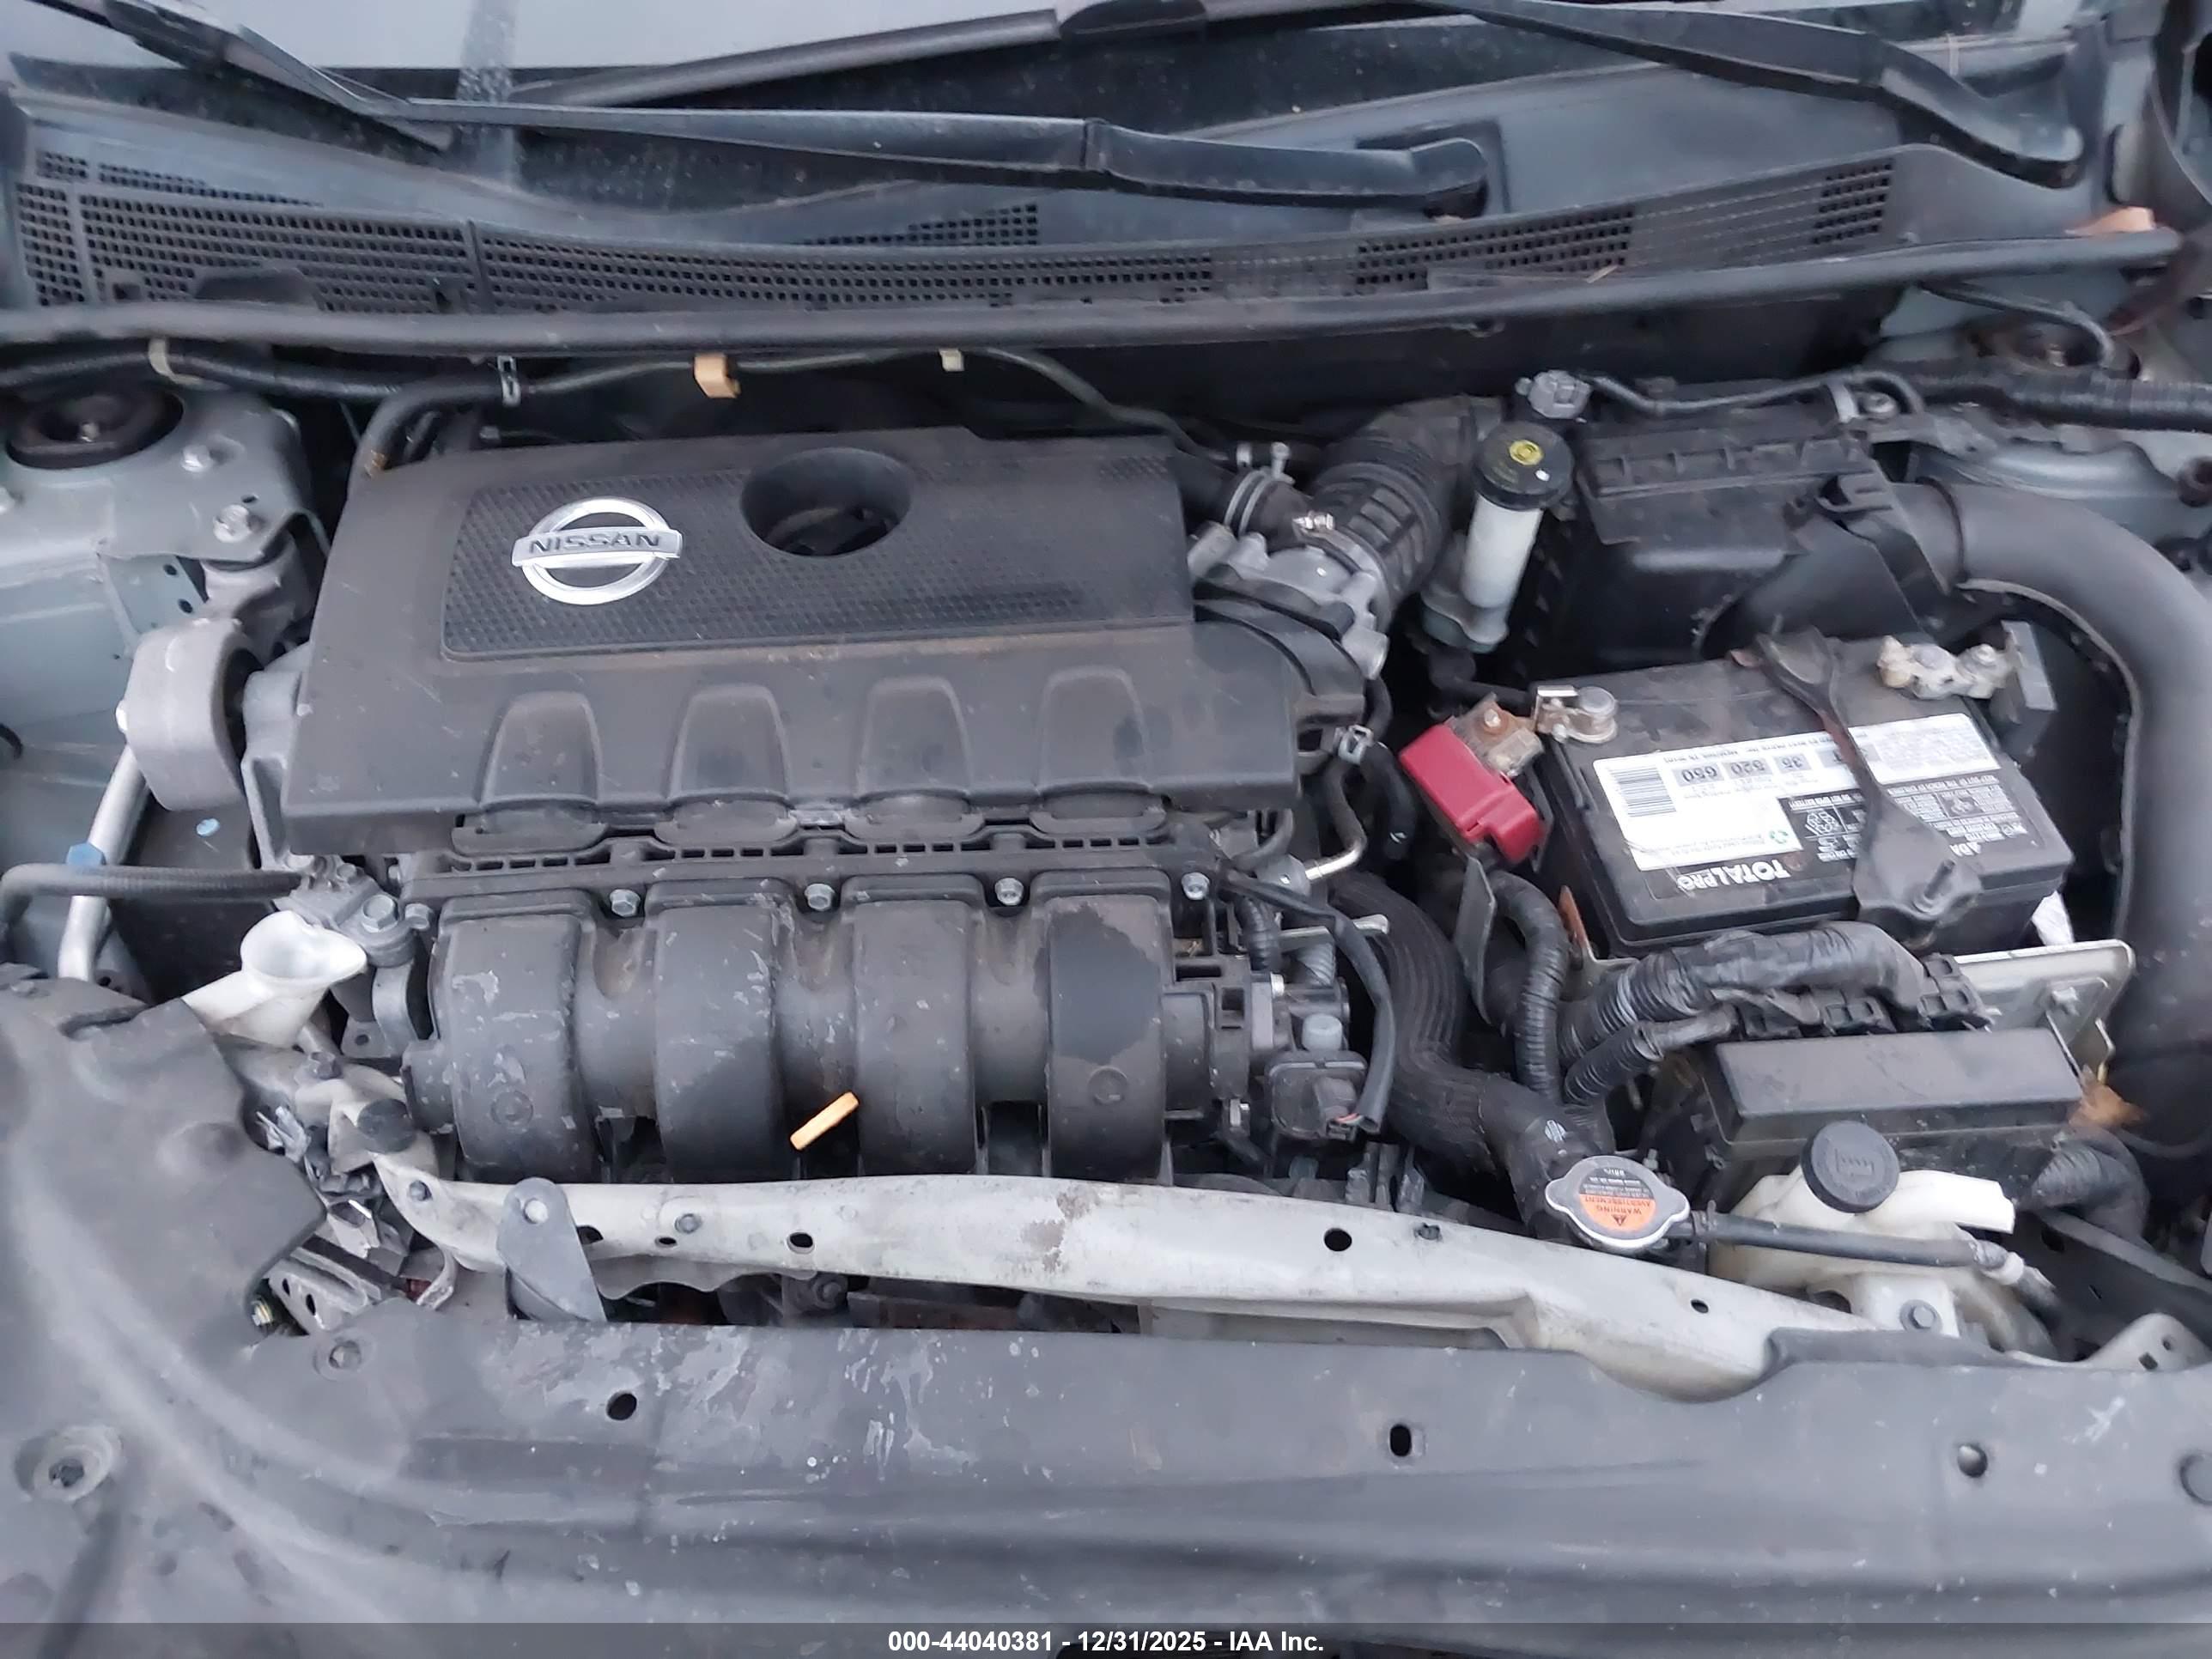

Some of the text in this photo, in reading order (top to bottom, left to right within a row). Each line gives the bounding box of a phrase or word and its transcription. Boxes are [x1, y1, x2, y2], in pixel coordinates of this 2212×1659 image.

[528, 532, 660, 555] NISSAN
[1676, 859, 1792, 891] TOTALPRO
[1595, 1204, 1643, 1216] WARNING
